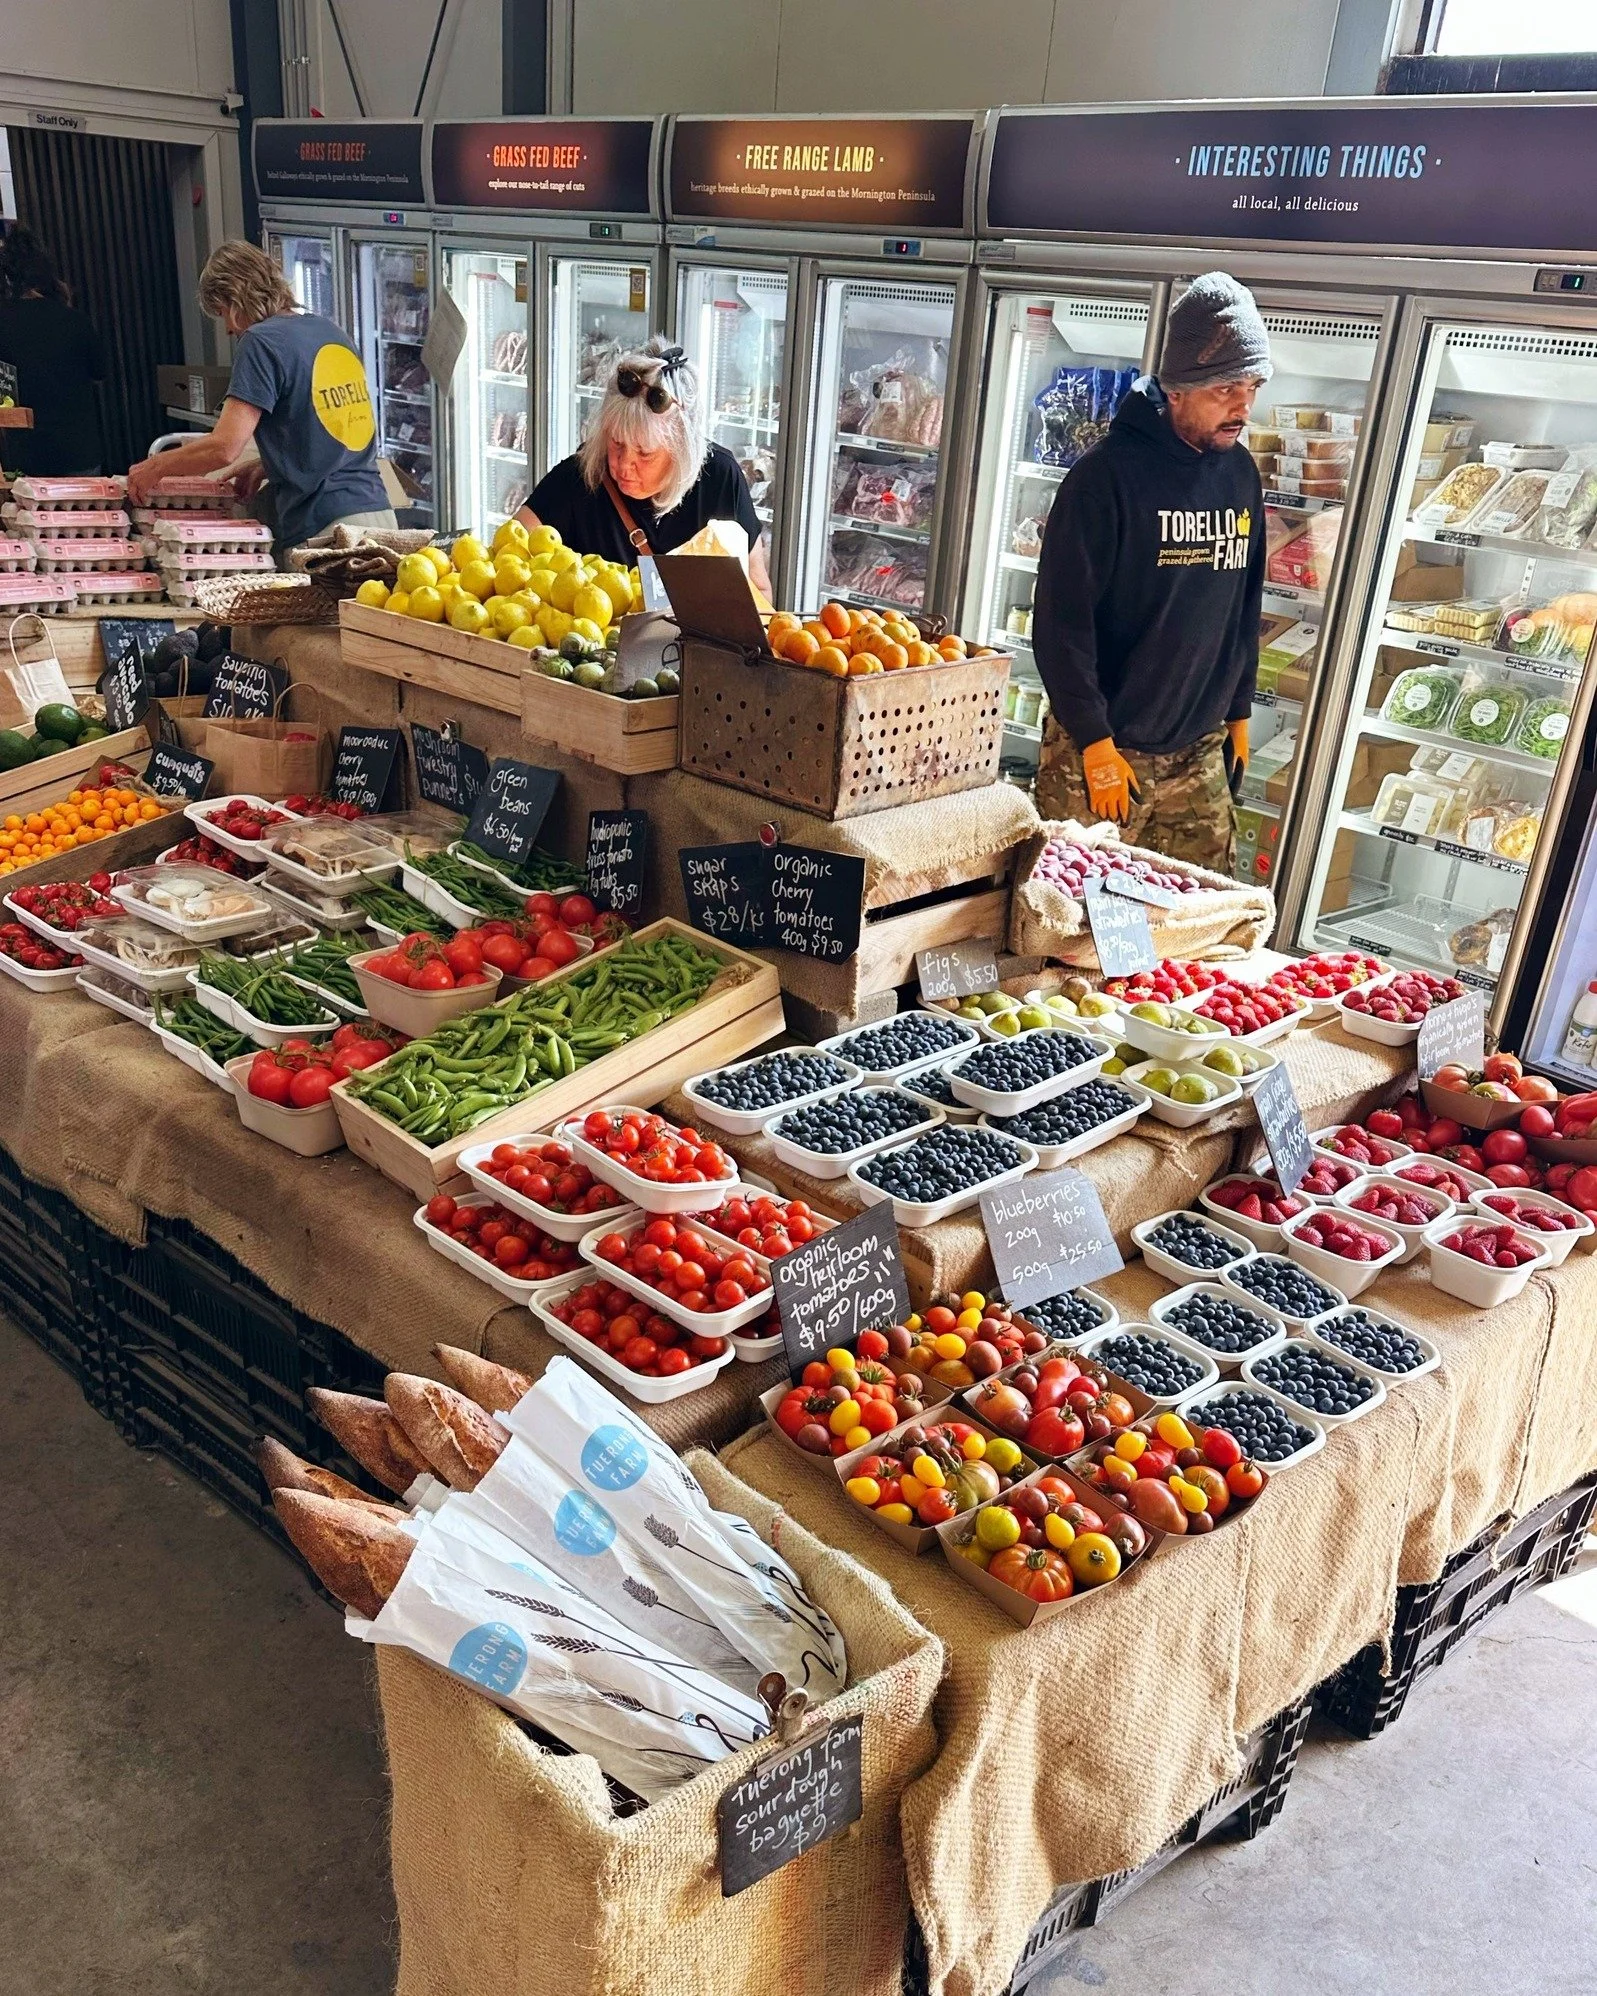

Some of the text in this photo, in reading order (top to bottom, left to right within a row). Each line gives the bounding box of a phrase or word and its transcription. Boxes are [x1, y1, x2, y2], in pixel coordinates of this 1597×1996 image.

[36, 113, 78, 129] Staff Only
[299, 142, 366, 161] GRASS FED BEEF
[493, 145, 580, 168] GRASS FED BEEF
[745, 145, 874, 172] FREE RANGE LAMB
[1187, 145, 1426, 178] INTERESTING THINGS
[488, 178, 507, 190] explore
[518, 180, 549, 190] nose-to-tail
[549, 182, 565, 193] range
[565, 181, 572, 190] of
[572, 182, 585, 191] cuts
[690, 181, 936, 203] heritage breeds ethically grown & grazed on the Mornington Peninsula
[1232, 195, 1359, 212] all local, all delicious
[1157, 508, 1237, 542] TORELLO
[1157, 556, 1182, 567] grazed
[1187, 554, 1214, 566] gathered
[1159, 548, 1210, 558] peninsula grown
[215, 671, 269, 706] tomatoes
[490, 768, 528, 793] green
[499, 786, 532, 815] beans
[586, 851, 606, 870] truss
[687, 857, 727, 880] sugar
[774, 901, 834, 931] tomatoes
[781, 928, 807, 952] 400g
[922, 952, 960, 981] figs
[928, 981, 957, 996] 200g
[1418, 1015, 1479, 1056] organically grown
[991, 1180, 1081, 1225] blueberries
[1005, 1206, 1086, 1249] 200g $10.50
[780, 1237, 838, 1286] organic
[810, 1235, 878, 1289] heirloom
[1012, 1239, 1103, 1285] 500g $25.50
[790, 1260, 870, 1325] tomatoes
[610, 1450, 642, 1485] FARM
[820, 1725, 861, 1762] farm
[749, 1782, 843, 1853] baguette
